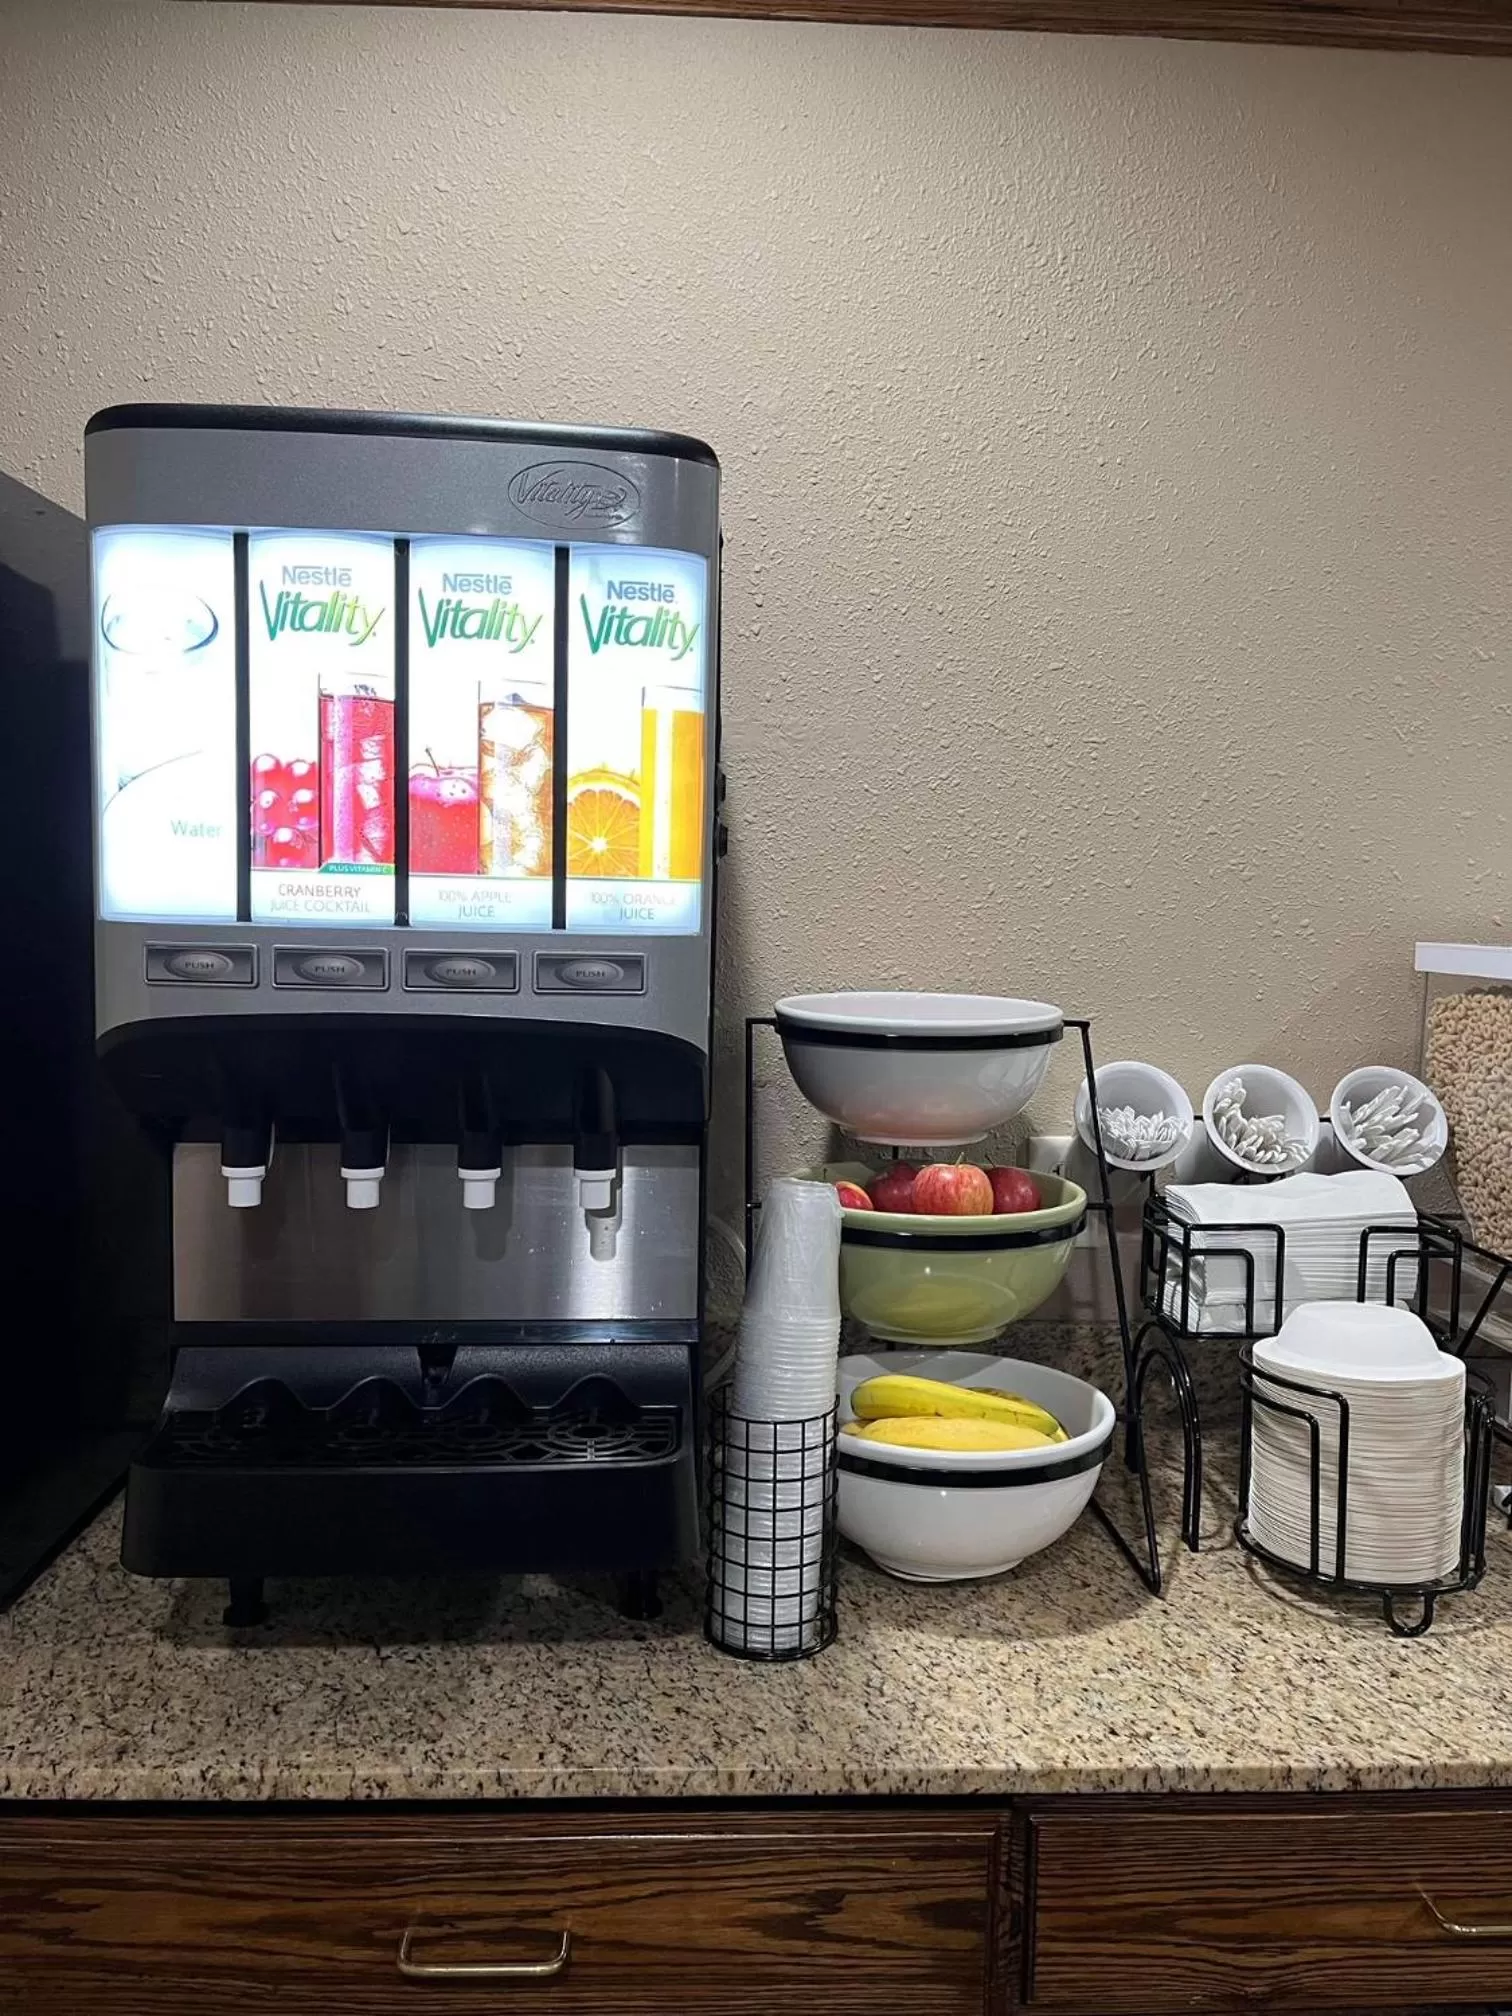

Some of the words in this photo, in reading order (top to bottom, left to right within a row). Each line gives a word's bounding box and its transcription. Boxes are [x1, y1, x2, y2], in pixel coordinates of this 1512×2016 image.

[259, 579, 385, 647] Vitality
[418, 587, 543, 654] Vitality
[580, 593, 701, 661] Vitality
[170, 819, 222, 838] Water
[278, 883, 361, 899] CRANBERRY
[304, 900, 369, 914] COCKTAIL
[458, 904, 495, 919] JUICE
[619, 907, 655, 921] JUICE
[184, 961, 214, 969] PUSH
[314, 966, 345, 974] PUSH
[446, 968, 477, 976] PUSH
[575, 970, 605, 978] PUSH
